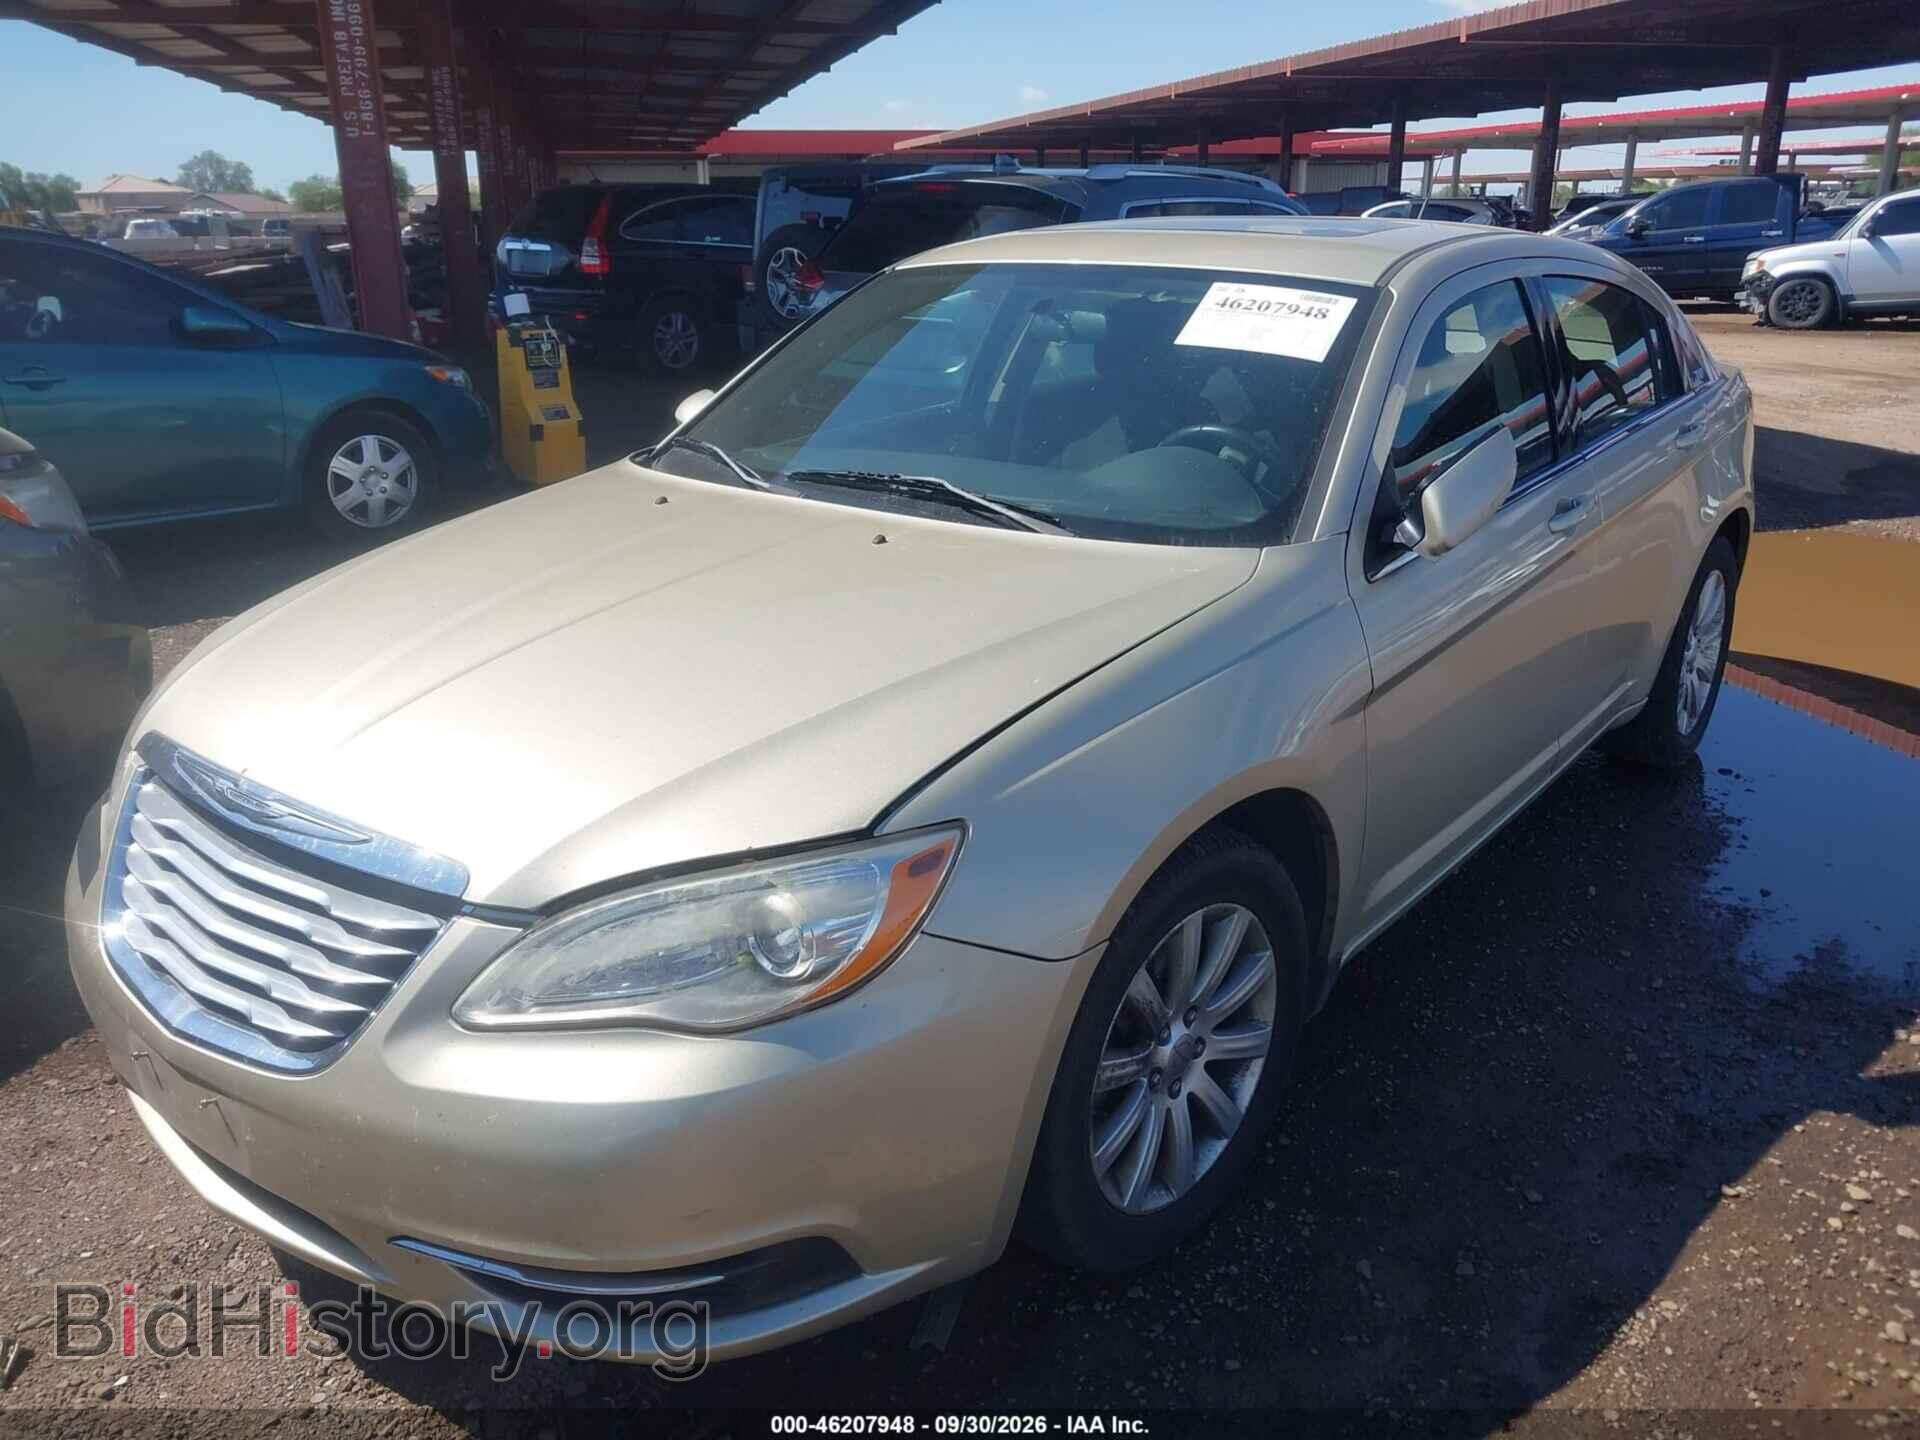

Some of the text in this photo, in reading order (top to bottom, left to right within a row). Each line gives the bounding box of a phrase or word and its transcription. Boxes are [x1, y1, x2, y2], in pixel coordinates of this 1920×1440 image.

[333, 31, 355, 96] PREFAB
[347, 0, 377, 136] 1-866-799-096
[1215, 297, 1330, 320] 46207948
